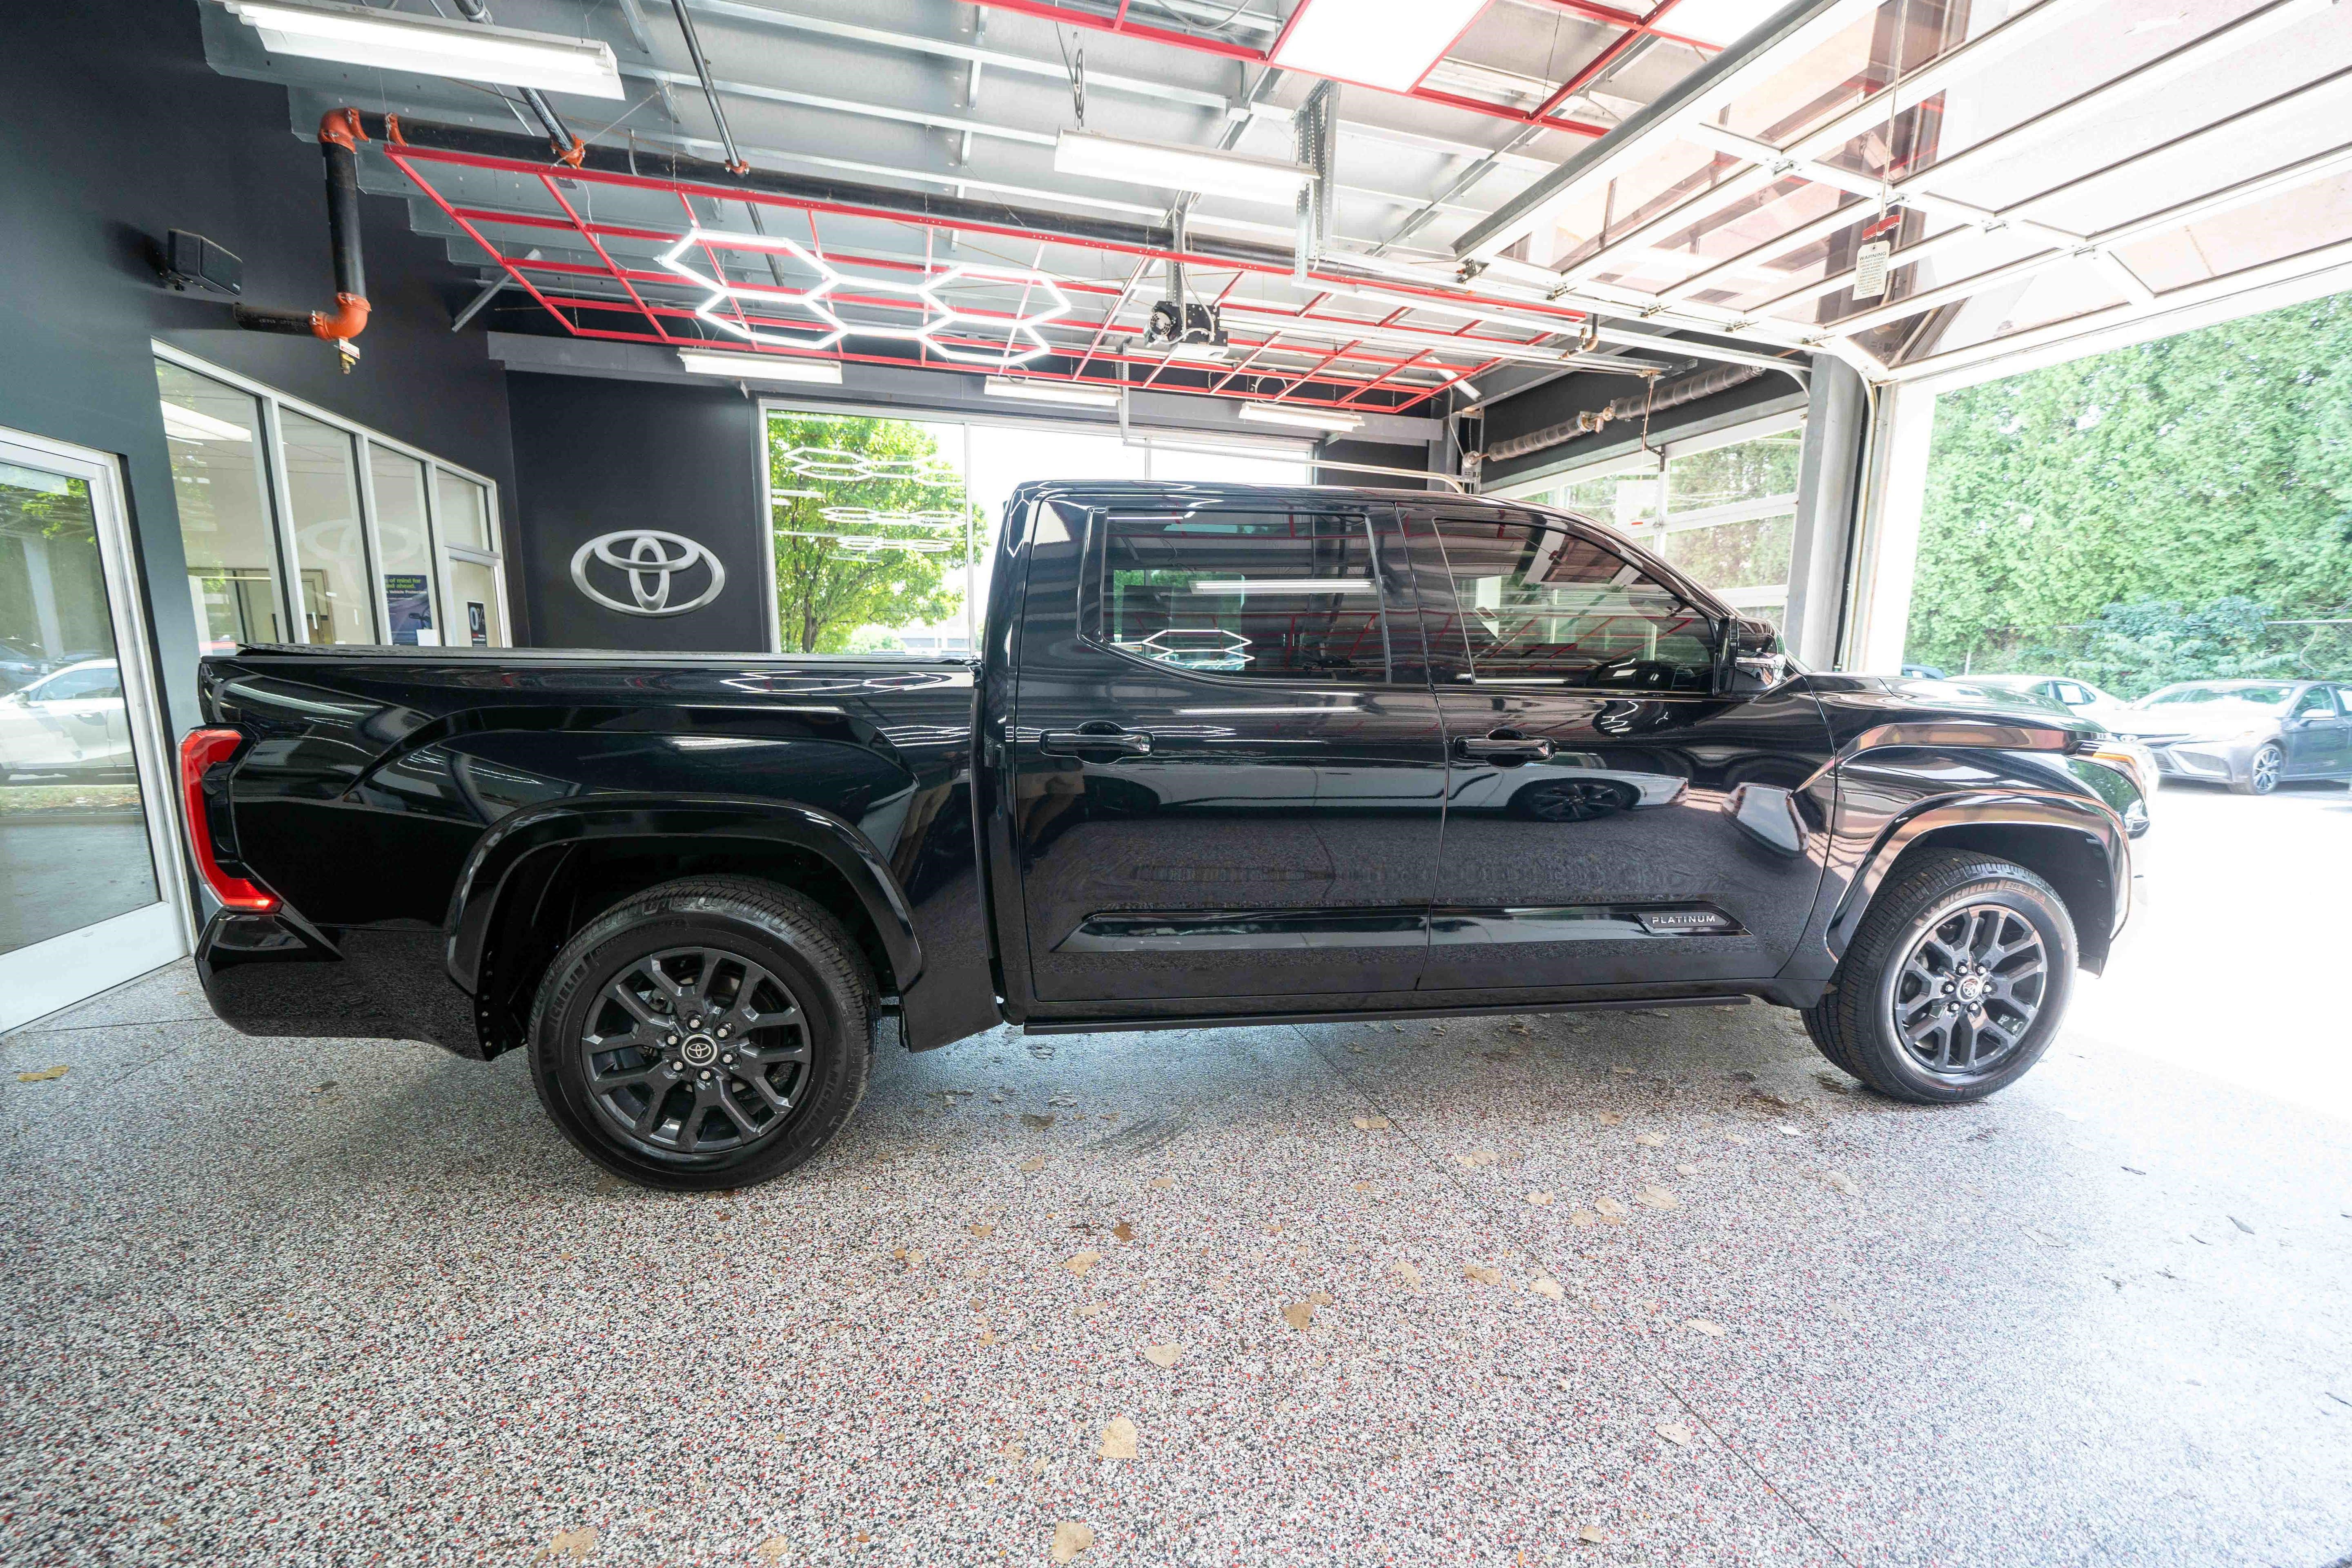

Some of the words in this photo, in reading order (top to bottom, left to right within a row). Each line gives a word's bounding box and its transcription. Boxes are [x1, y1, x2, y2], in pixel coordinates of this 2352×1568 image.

[1859, 252, 1886, 261] WARNING
[1940, 881, 1998, 909] MICHELIN
[1652, 915, 1715, 924] PLATINUM
